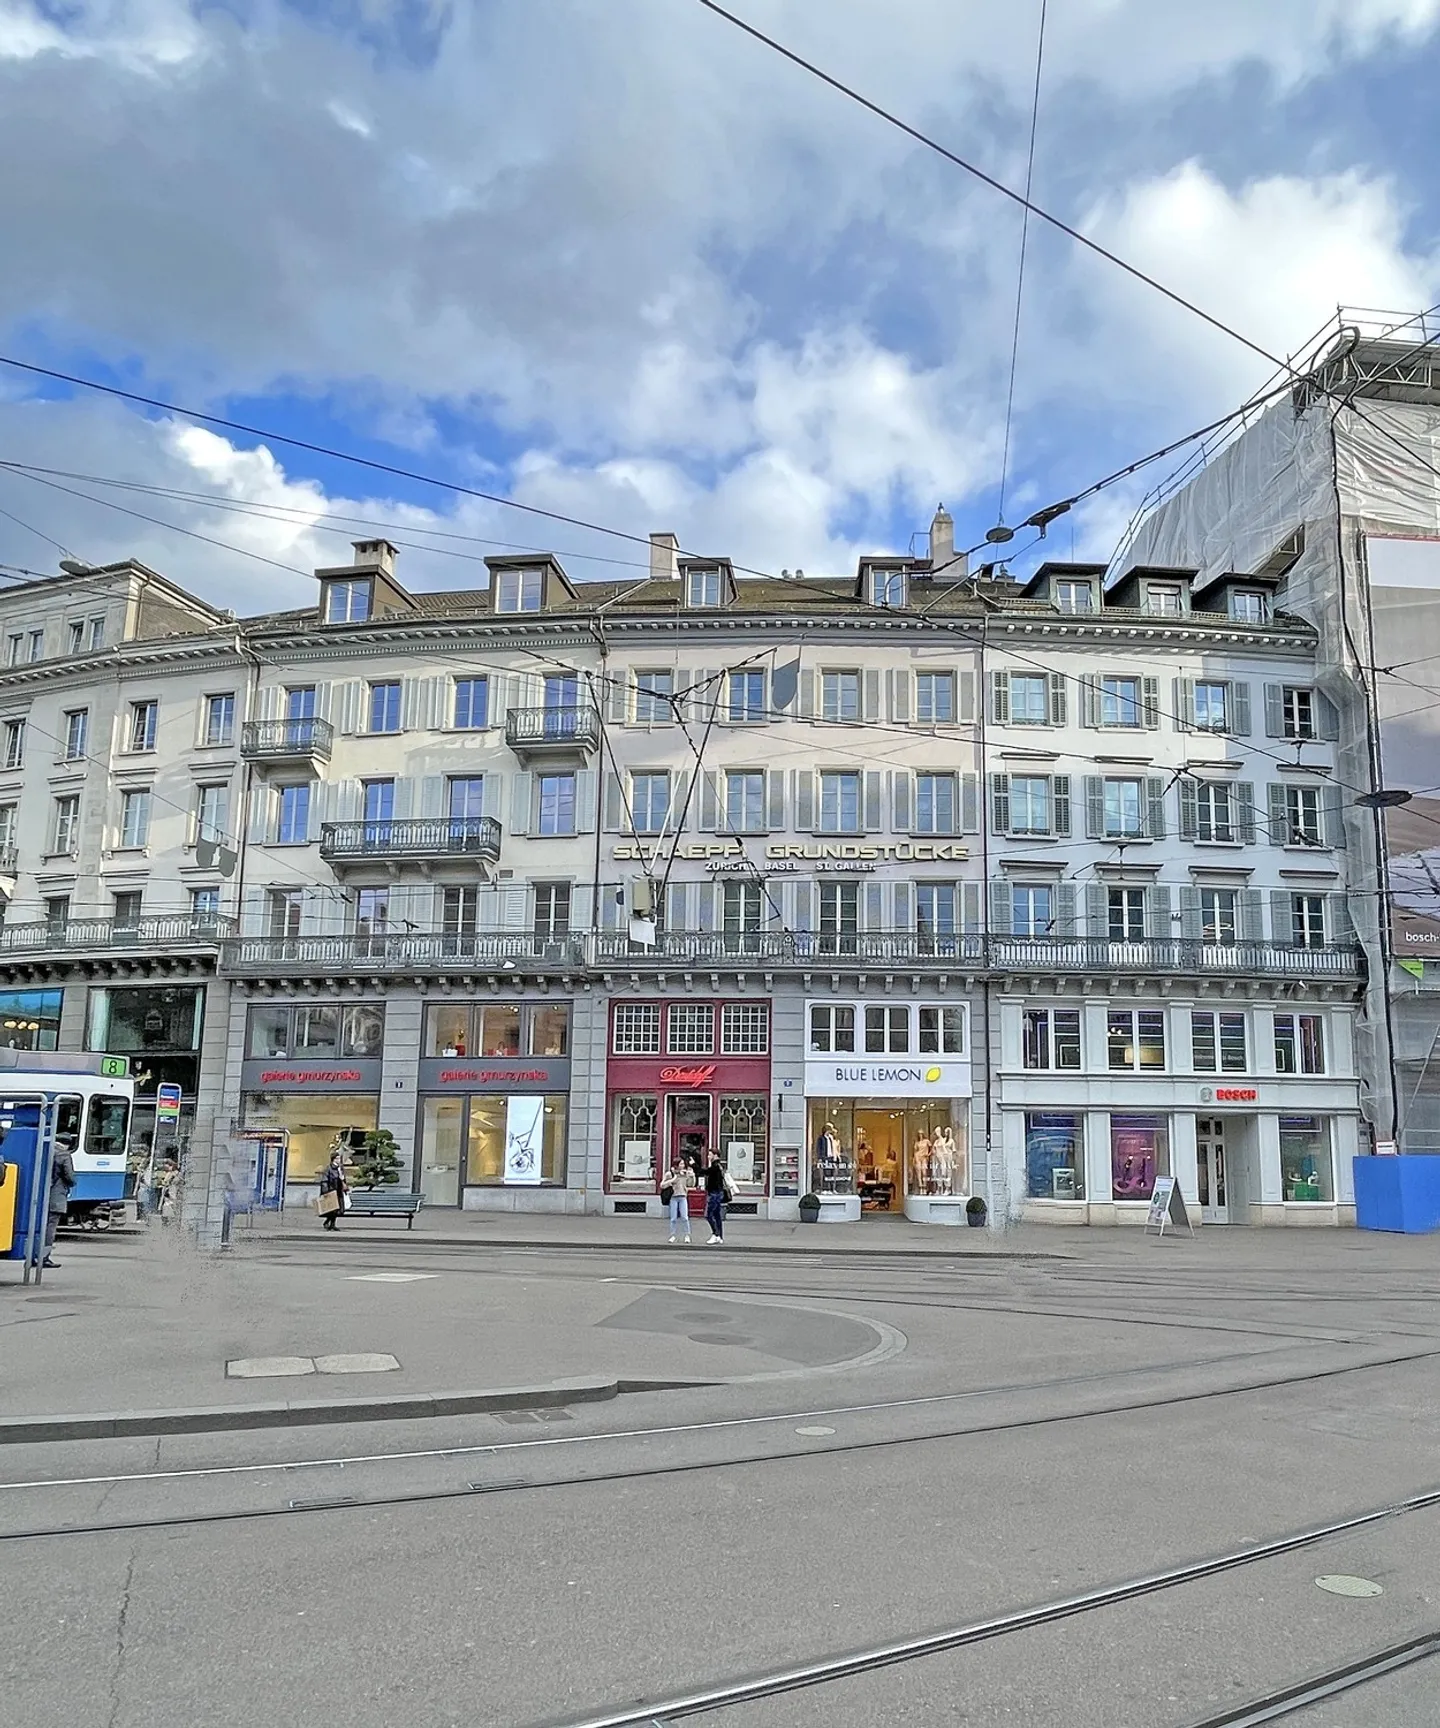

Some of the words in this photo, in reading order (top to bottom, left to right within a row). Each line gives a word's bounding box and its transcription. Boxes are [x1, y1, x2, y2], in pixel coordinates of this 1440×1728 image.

[613, 844, 747, 860] SCHAEPPI
[765, 841, 969, 861] GRUNDSTÜCKE
[765, 862, 800, 871] BASEL
[835, 862, 876, 872] GALLEN
[109, 1060, 117, 1074] 8
[836, 1068, 867, 1081] BLUE
[872, 1068, 921, 1081] LEMON
[1216, 1089, 1257, 1101] BOSCH
